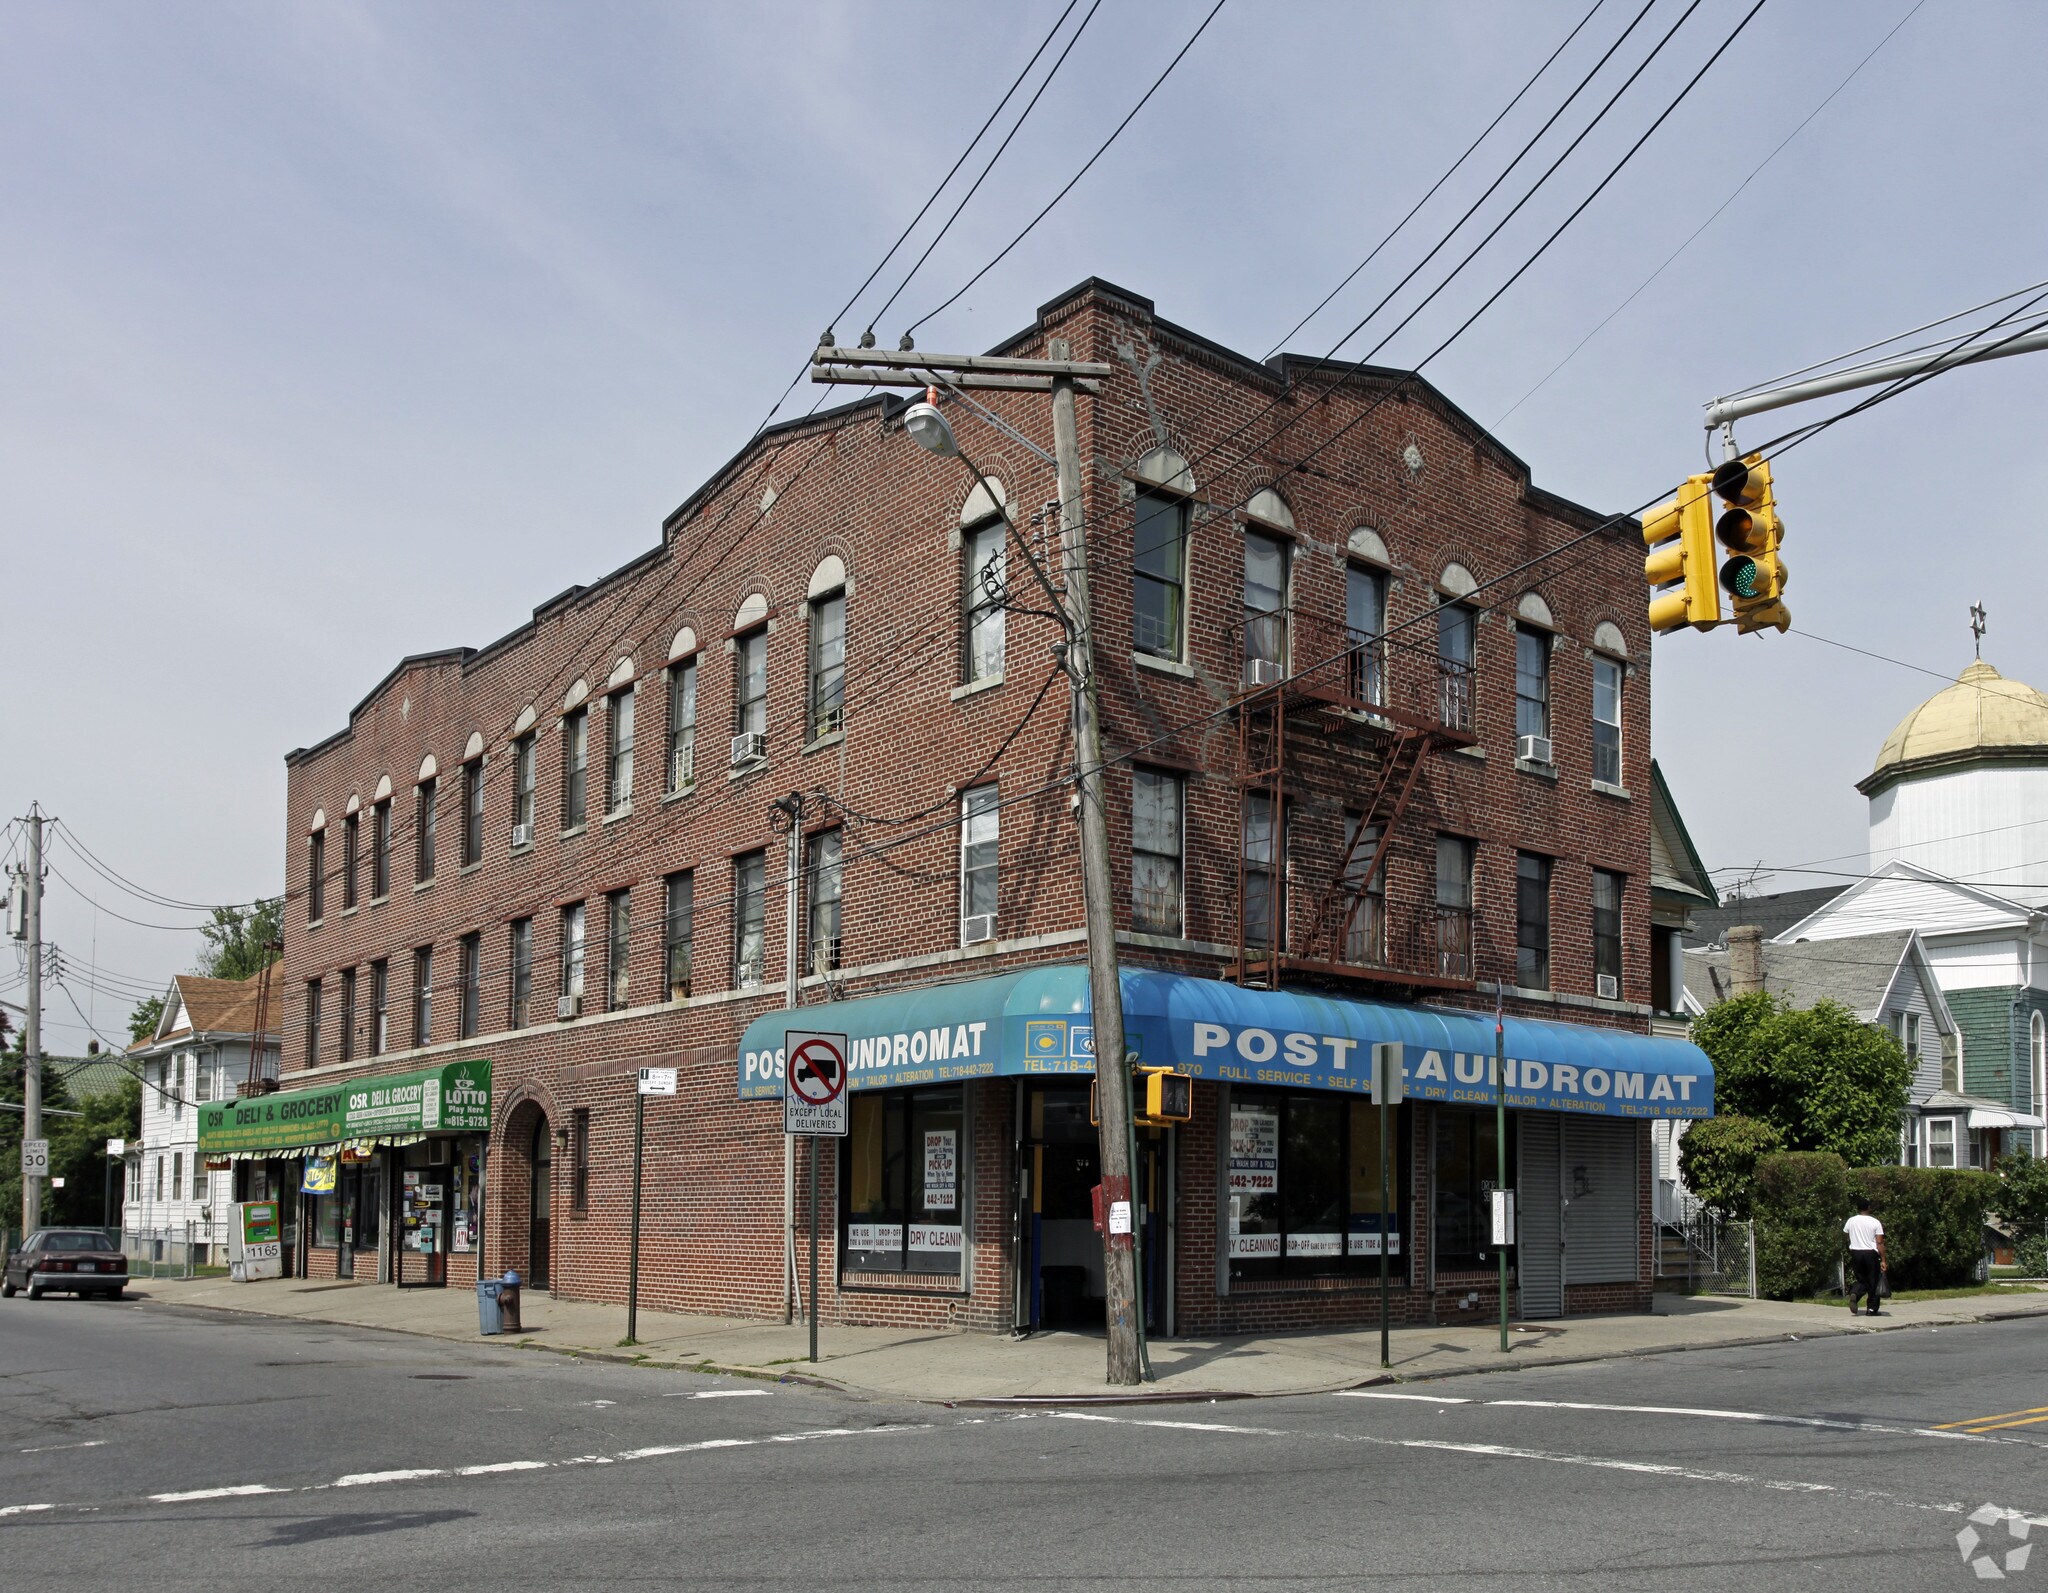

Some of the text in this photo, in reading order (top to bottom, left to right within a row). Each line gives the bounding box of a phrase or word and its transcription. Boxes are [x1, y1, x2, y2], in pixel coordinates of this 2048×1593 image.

[744, 1048, 784, 1080] POS
[1193, 1022, 1697, 1101] POST AUNDROMAT
[1177, 1063, 1203, 1075] 970
[741, 1088, 753, 1097] FULL
[755, 1085, 777, 1096] SERVICE
[866, 1074, 887, 1087] TAILOR
[895, 1070, 934, 1083] ALTERATION
[939, 1063, 994, 1079] TEL:718-442-7222
[1219, 1065, 1251, 1080] FULL
[1257, 1069, 1311, 1084] SERVICE
[1328, 1075, 1357, 1088] SELF
[350, 1084, 423, 1110] OSR DELI & GROCERY
[445, 1089, 487, 1105] LOTTO
[1425, 1086, 1709, 1116] DRY CLEAN TAILOR ALTERATION TEL:718 442-7222
[207, 1111, 224, 1127] OSR
[236, 1106, 260, 1125] DELI
[266, 1104, 274, 1121] &
[281, 1094, 342, 1121] GROCERY
[448, 1105, 484, 1115] Play Here
[790, 1107, 842, 1118] EXCEPT LOCAL
[451, 1115, 488, 1127] 815-9728
[796, 1120, 837, 1129] DELIVERIES
[927, 1136, 942, 1147] DROP
[24, 1154, 46, 1167] 30
[928, 1159, 952, 1170] PICK-UP
[1265, 1160, 1275, 1168] FOLD
[852, 1228, 859, 1236] WE
[878, 1228, 901, 1236] DROP-OFF
[910, 1230, 926, 1245] DRY
[1239, 1238, 1279, 1253] CLEANING
[1287, 1240, 1310, 1250] ROP-OFF
[1353, 1240, 1363, 1248] USE
[1365, 1239, 1376, 1248] TIDE
